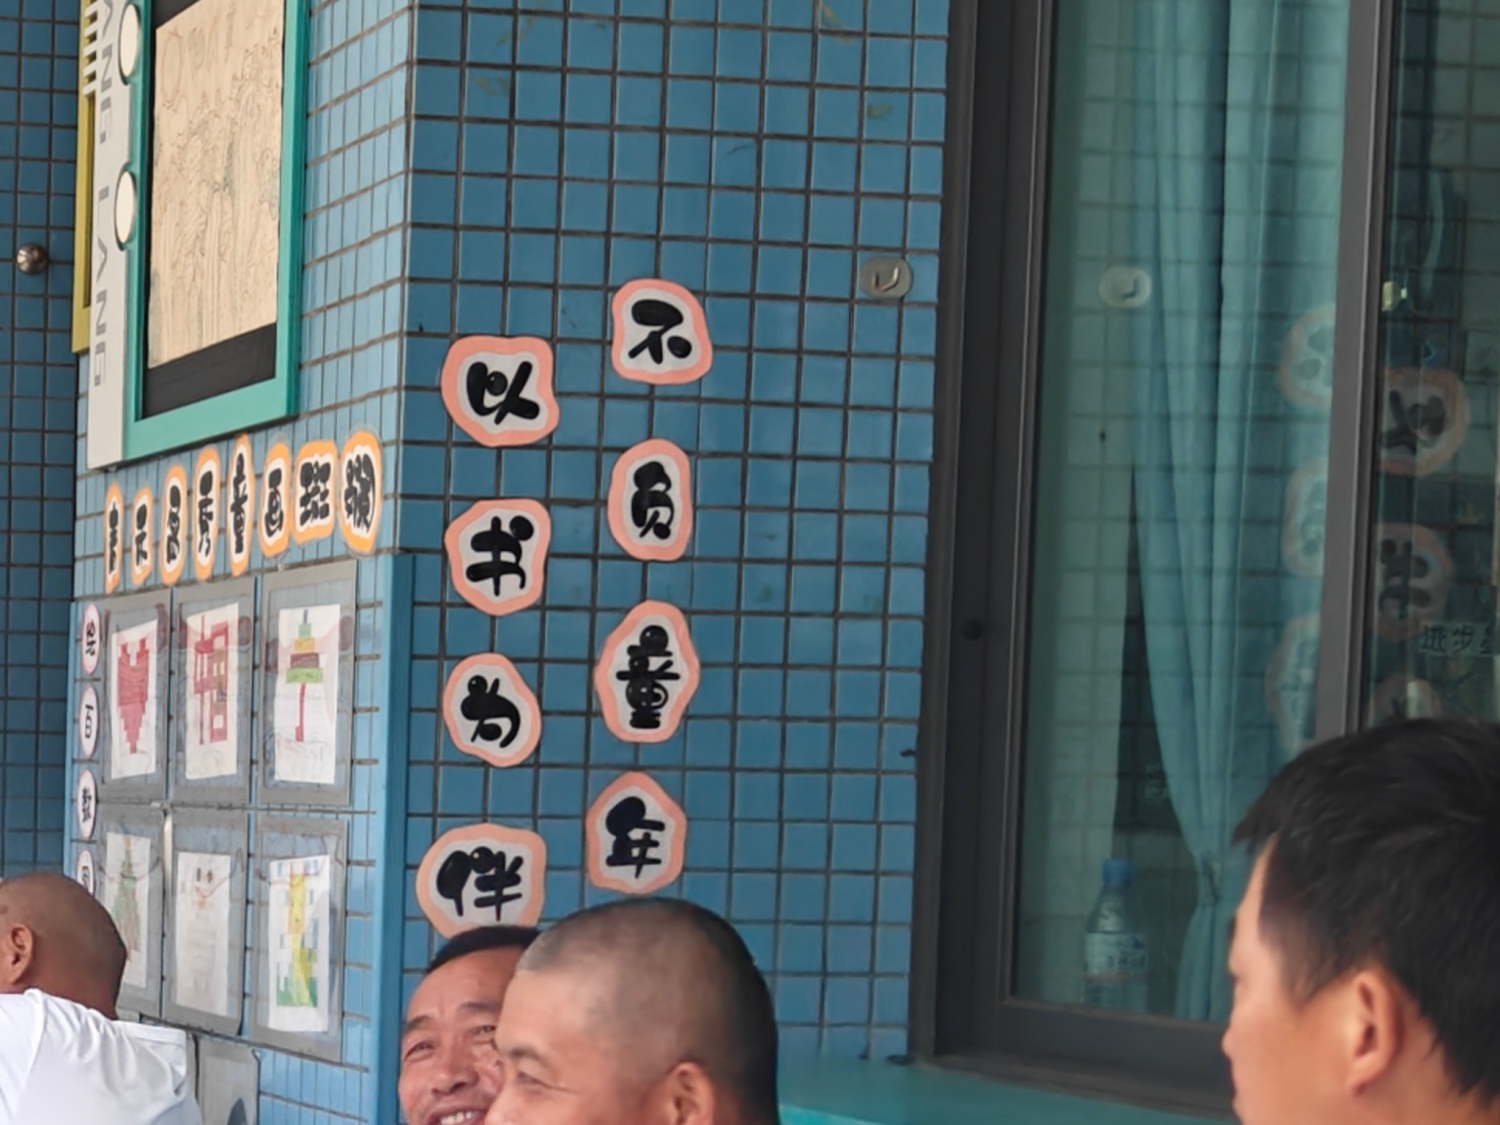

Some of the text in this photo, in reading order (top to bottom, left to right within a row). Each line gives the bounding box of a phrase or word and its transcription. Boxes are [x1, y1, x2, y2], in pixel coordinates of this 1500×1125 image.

[437, 360, 540, 922] 以书为伴
[606, 298, 692, 879] 不负童年
